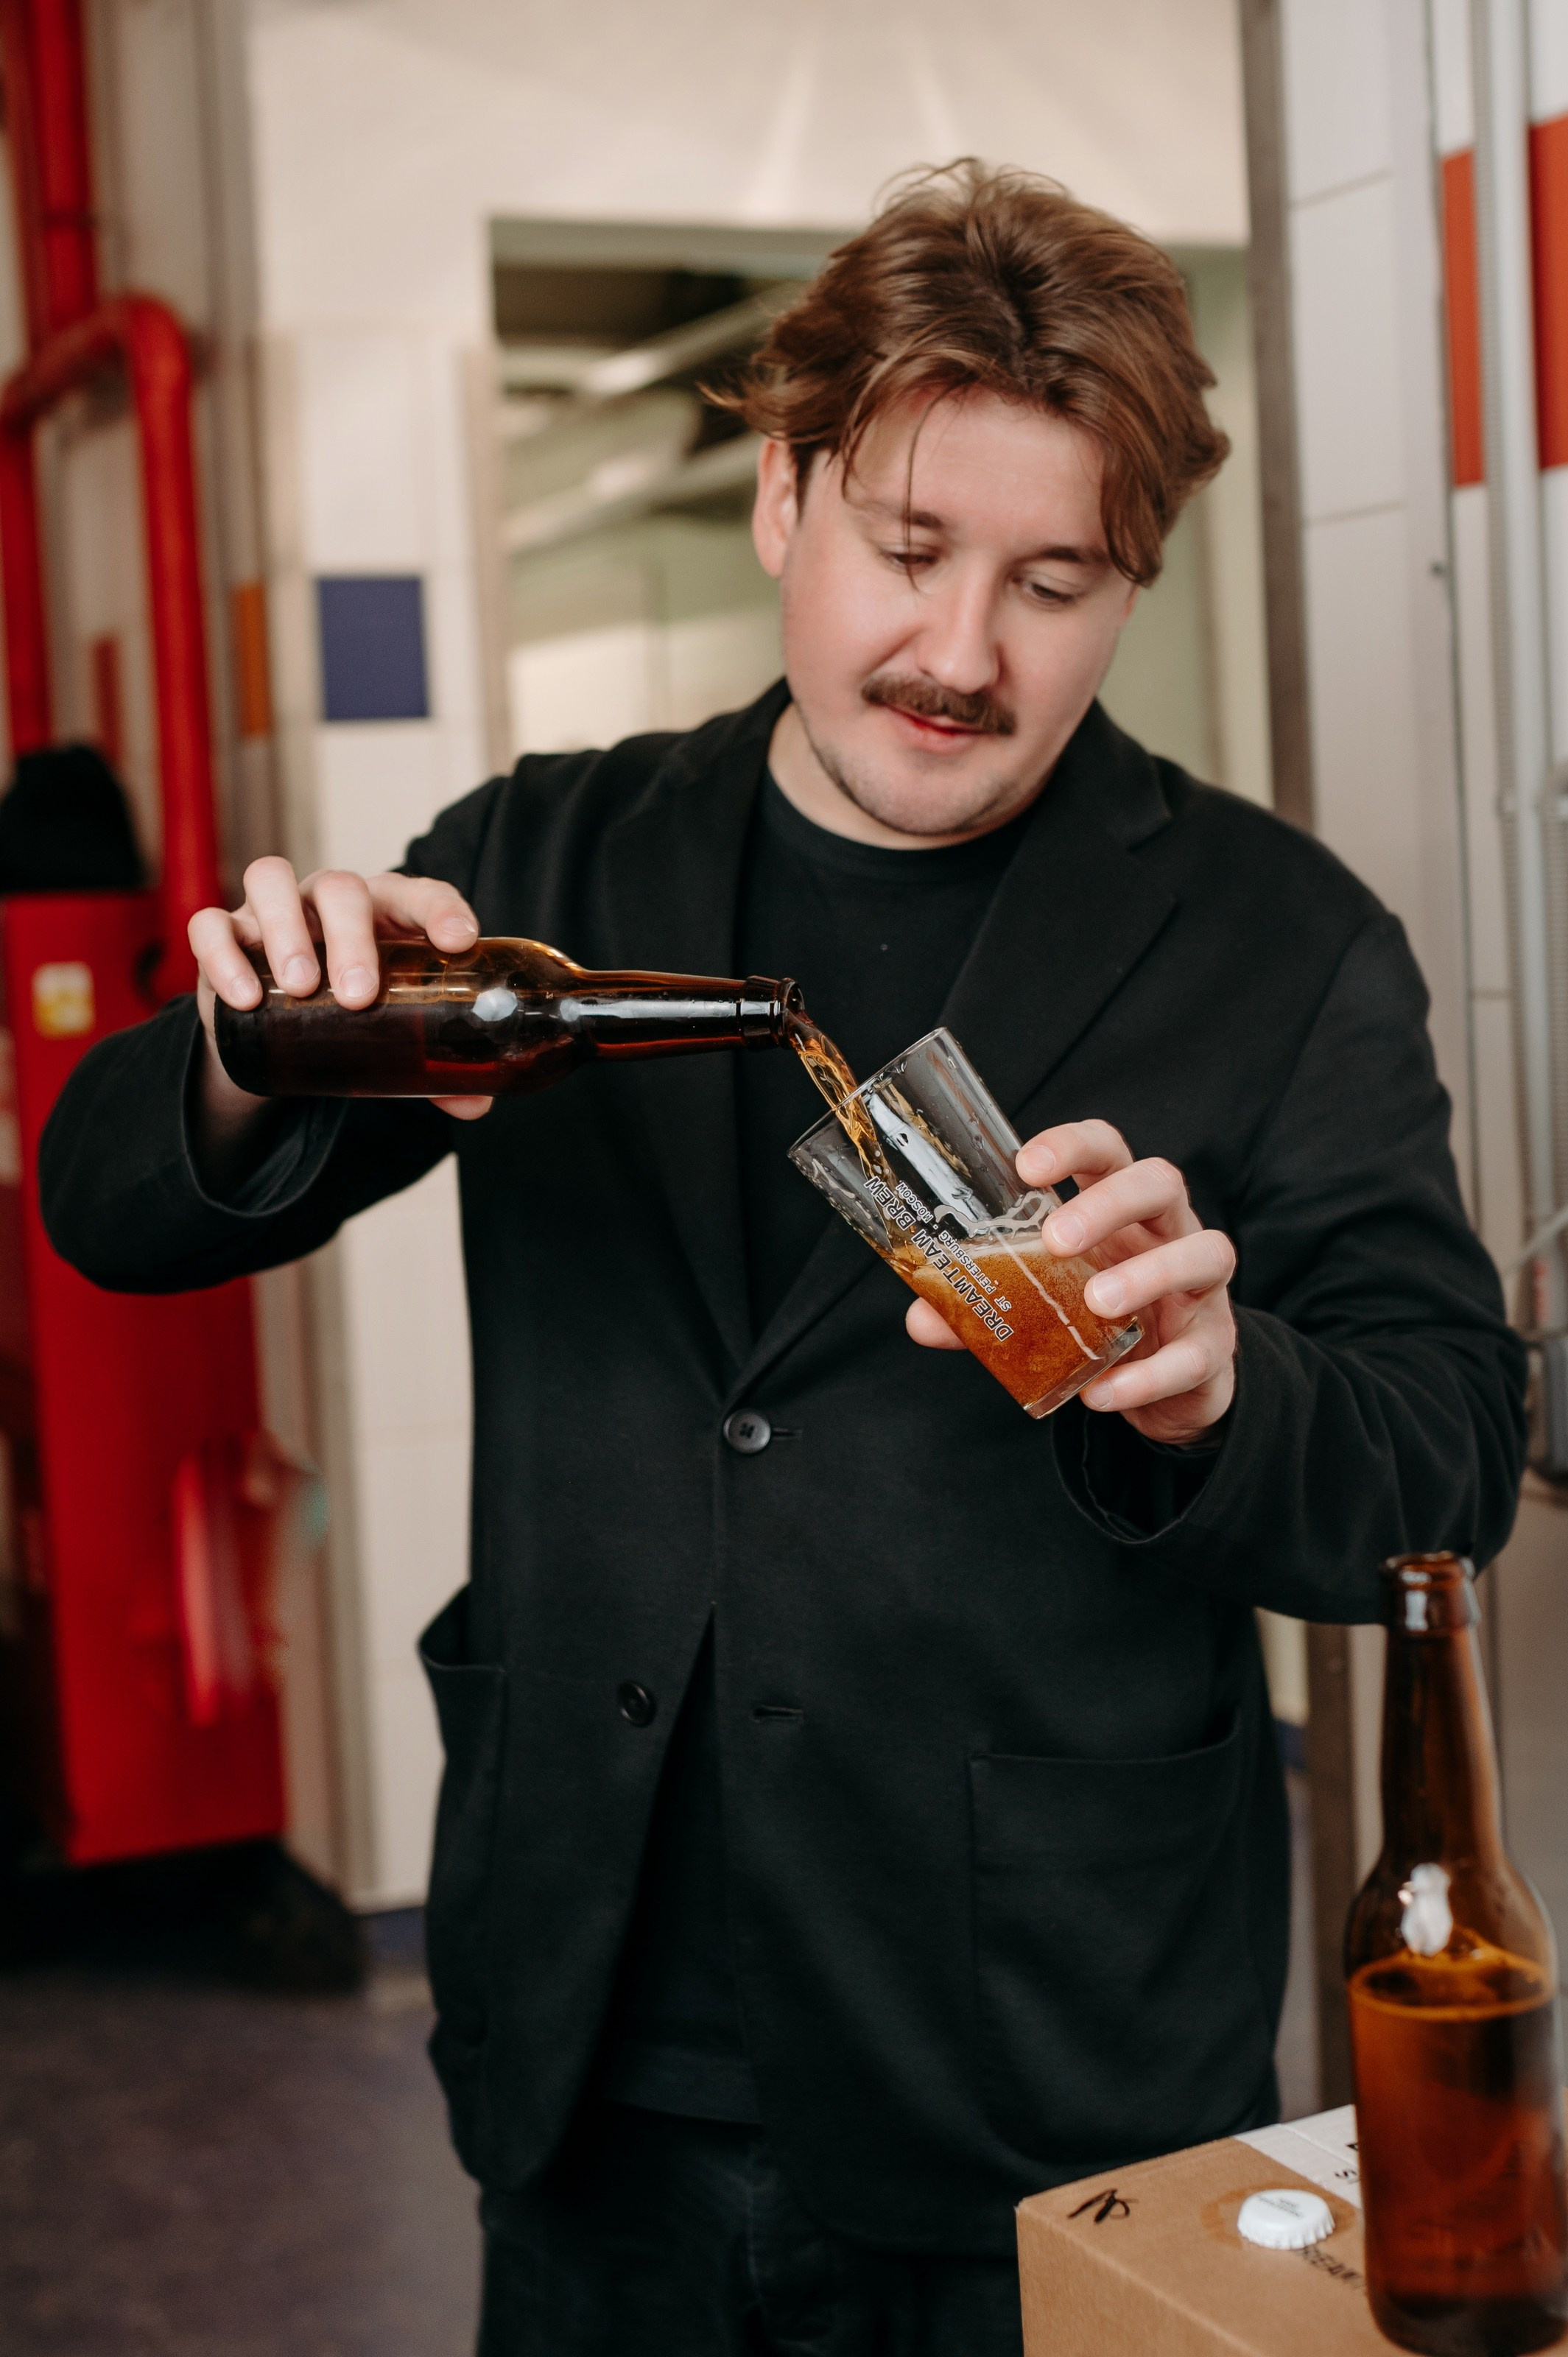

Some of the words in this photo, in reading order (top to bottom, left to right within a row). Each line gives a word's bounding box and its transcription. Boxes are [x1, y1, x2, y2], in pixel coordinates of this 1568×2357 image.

[864, 1176, 916, 1231] BREW
[896, 1182, 934, 1223] MOSCOW
[911, 1229, 1014, 1341] DREAMTEAM
[938, 1230, 997, 1294] PETERSBURG
[994, 1296, 1011, 1312] ST
